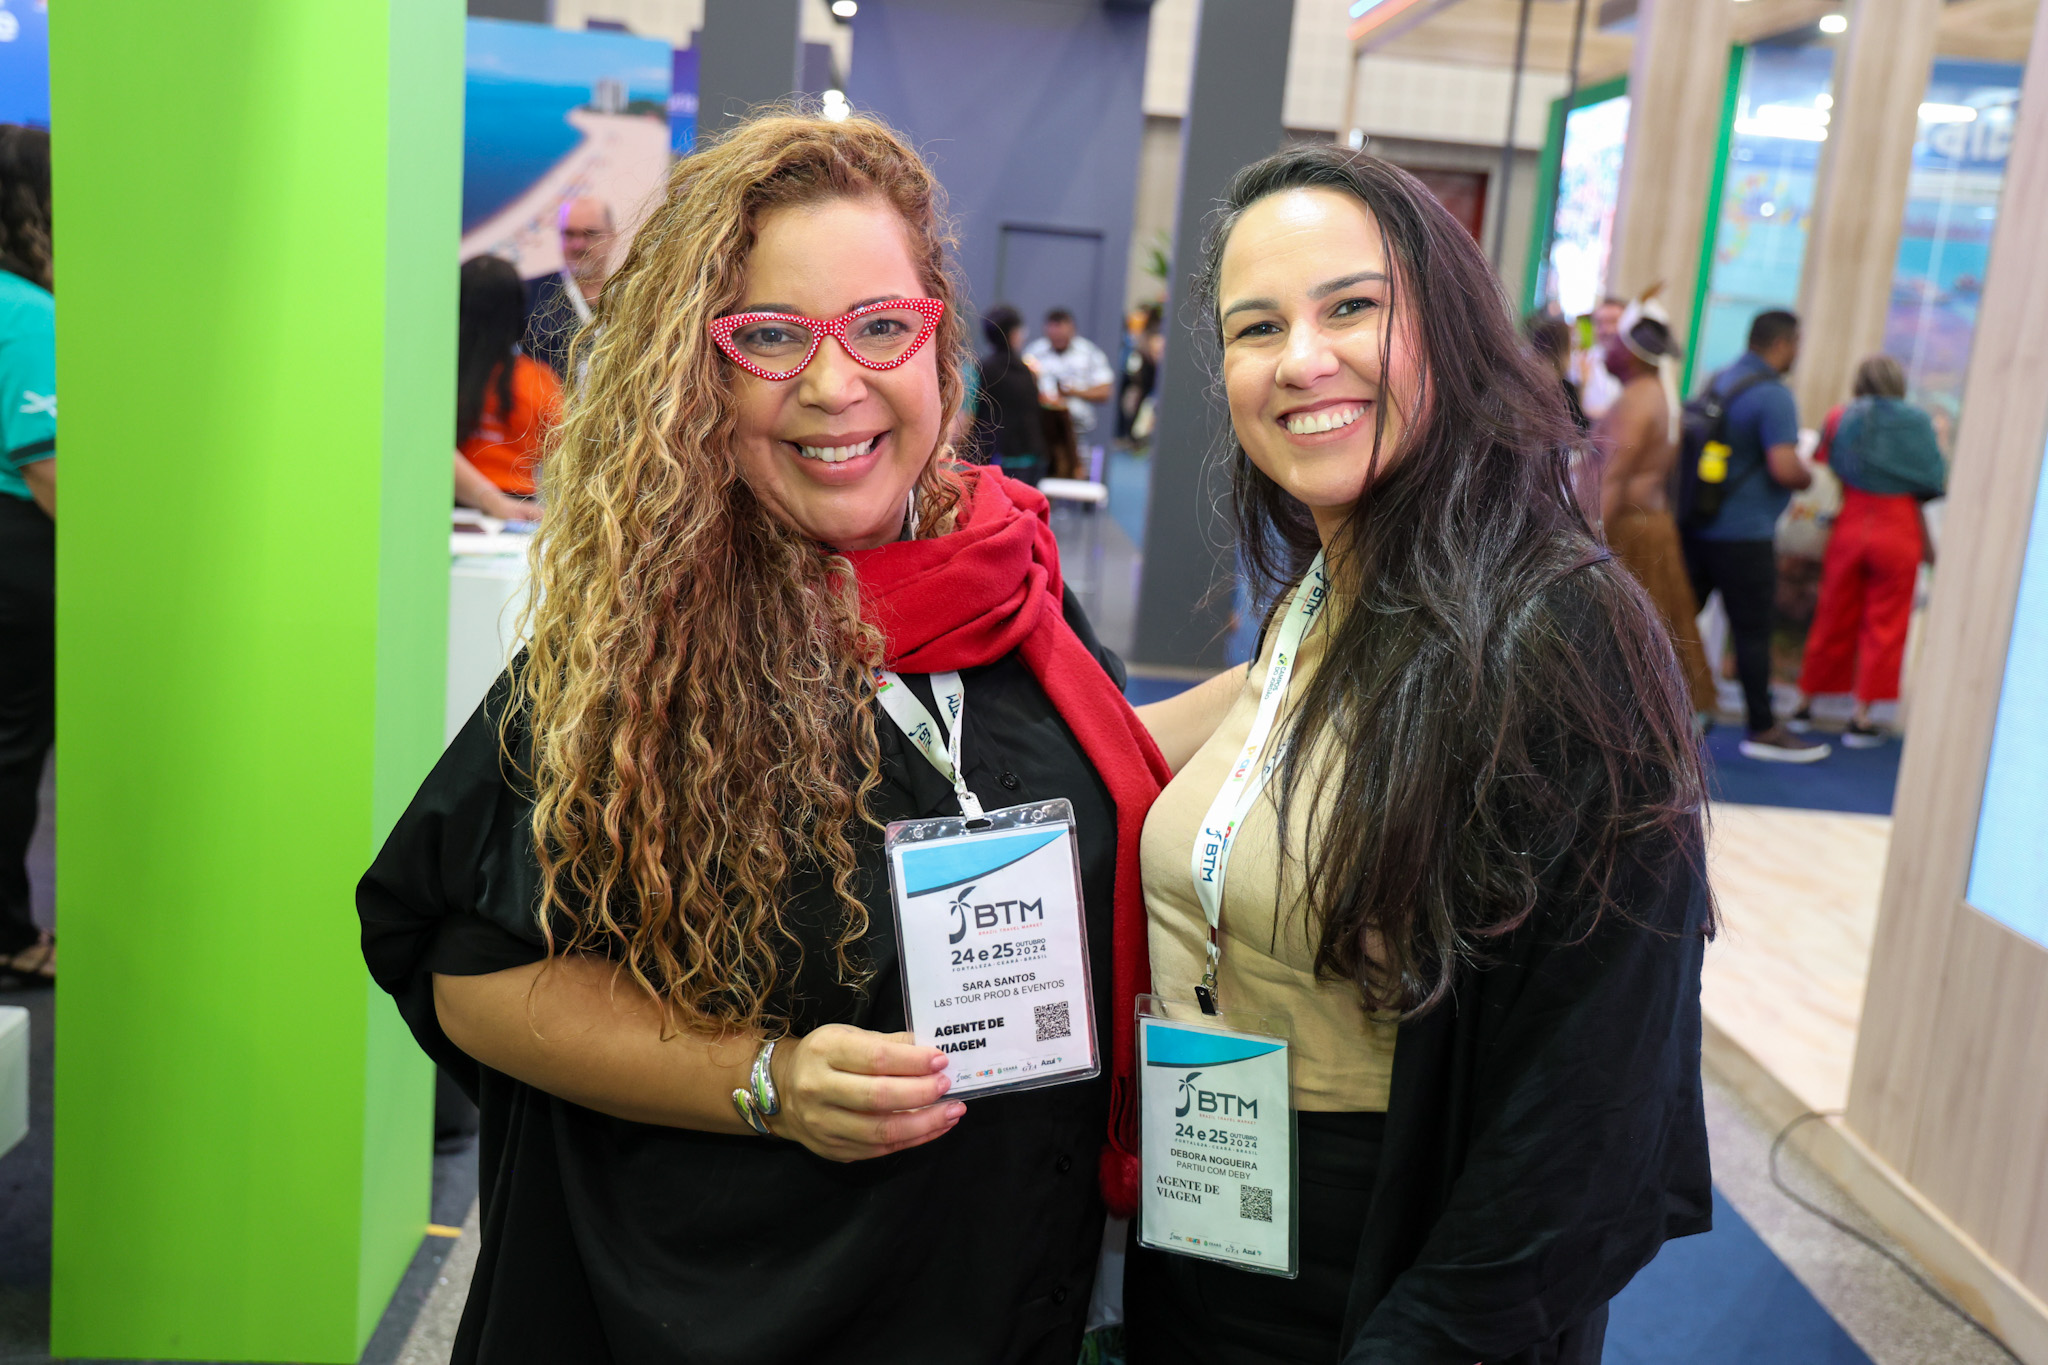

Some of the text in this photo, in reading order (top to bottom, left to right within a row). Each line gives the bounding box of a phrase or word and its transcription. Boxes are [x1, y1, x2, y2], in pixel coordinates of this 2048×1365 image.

[919, 727, 932, 752] BTM
[1202, 843, 1219, 882] BTM
[974, 896, 1044, 929] BTM
[1015, 938, 1046, 948] OUTUBRO
[1016, 944, 1046, 956] 2024
[951, 942, 1014, 966] 24 e 25
[952, 963, 992, 972] FORTALEZA
[1023, 954, 1048, 963] BRASIL
[962, 972, 1036, 992] SARA SANTOS
[934, 979, 1065, 1008] L&S TOUR PROD & EVENTOS
[934, 1017, 1005, 1037] AGENTE DE
[936, 1037, 986, 1054] VIAGEM
[1041, 1058, 1056, 1066] Azul
[1198, 1090, 1258, 1119] BTM
[1175, 1123, 1228, 1144] 24 e 25
[1229, 1132, 1258, 1142] OUTUBRO
[1230, 1138, 1258, 1149] 2024
[1170, 1148, 1258, 1171] DEBORA NOGUEIRA
[1235, 1148, 1258, 1156] BRASIL
[1176, 1160, 1251, 1180] PARTIU COM DEBY
[1156, 1174, 1220, 1195] AGENTE DE
[1156, 1186, 1202, 1205] VIAGEM
[1242, 1248, 1256, 1256] Azul
